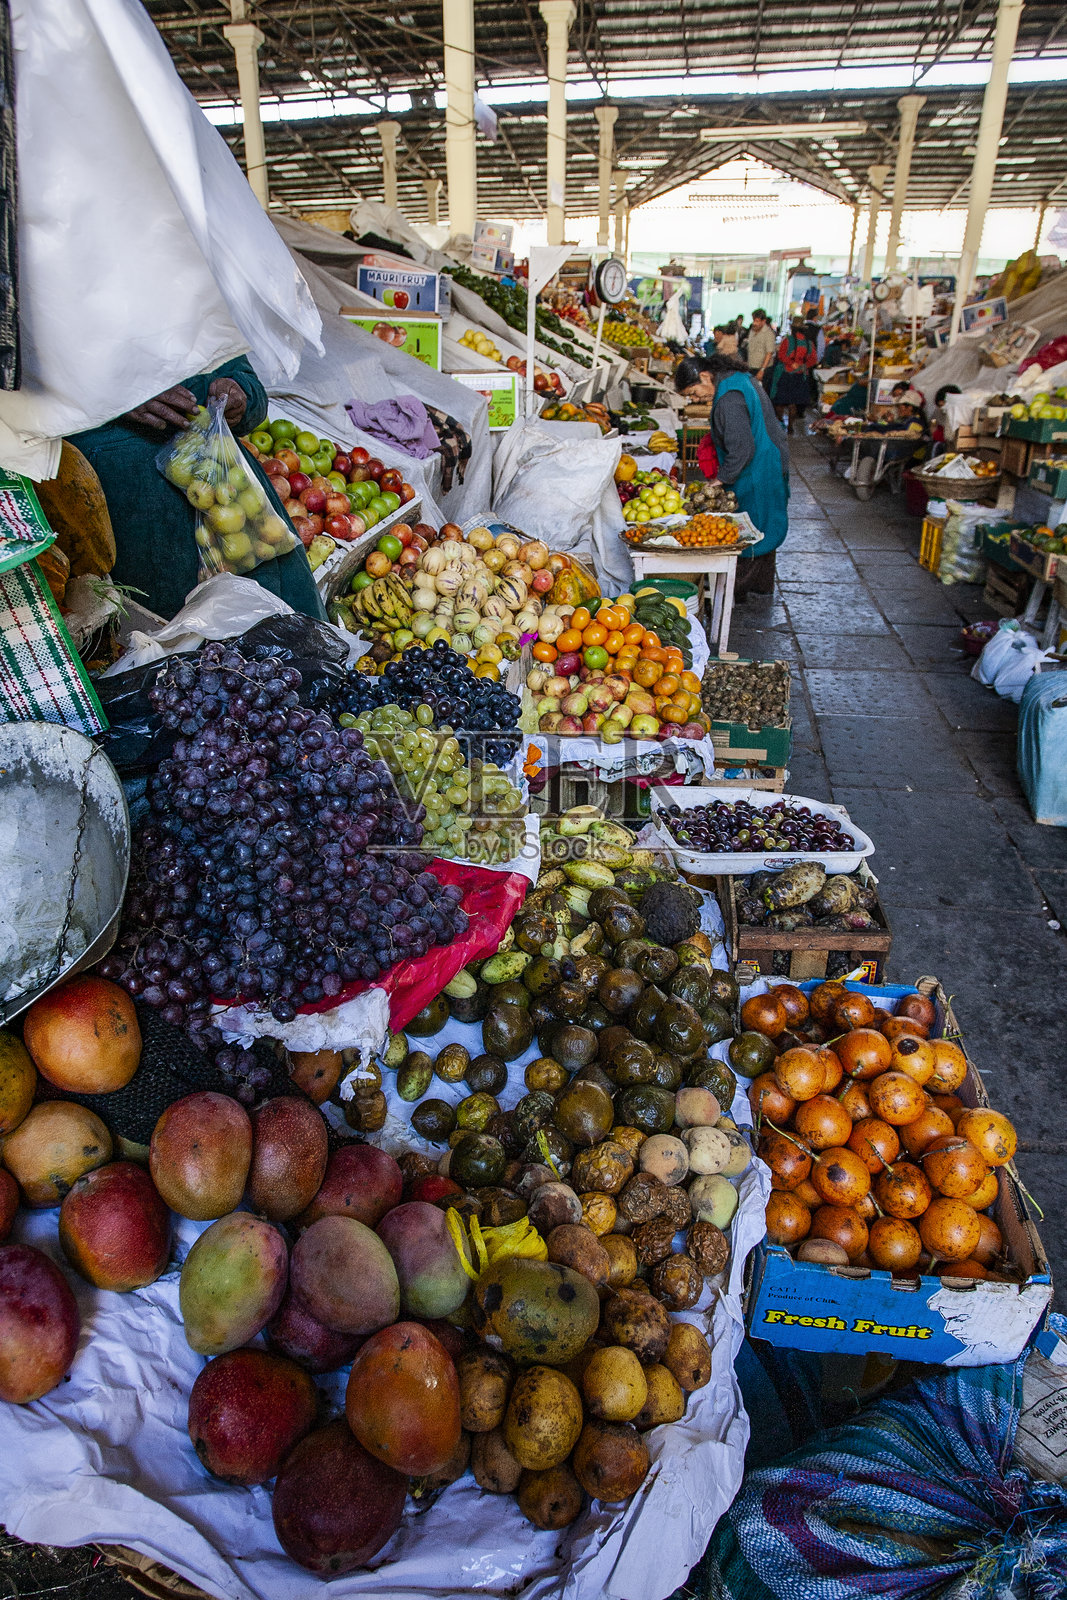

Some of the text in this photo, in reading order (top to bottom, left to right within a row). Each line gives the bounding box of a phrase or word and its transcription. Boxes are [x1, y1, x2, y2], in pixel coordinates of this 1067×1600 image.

[367, 271, 398, 283] MAURI
[402, 274, 427, 286] FRUT
[767, 1293, 803, 1301] Produce
[763, 1309, 934, 1340] Fresh Fruit
